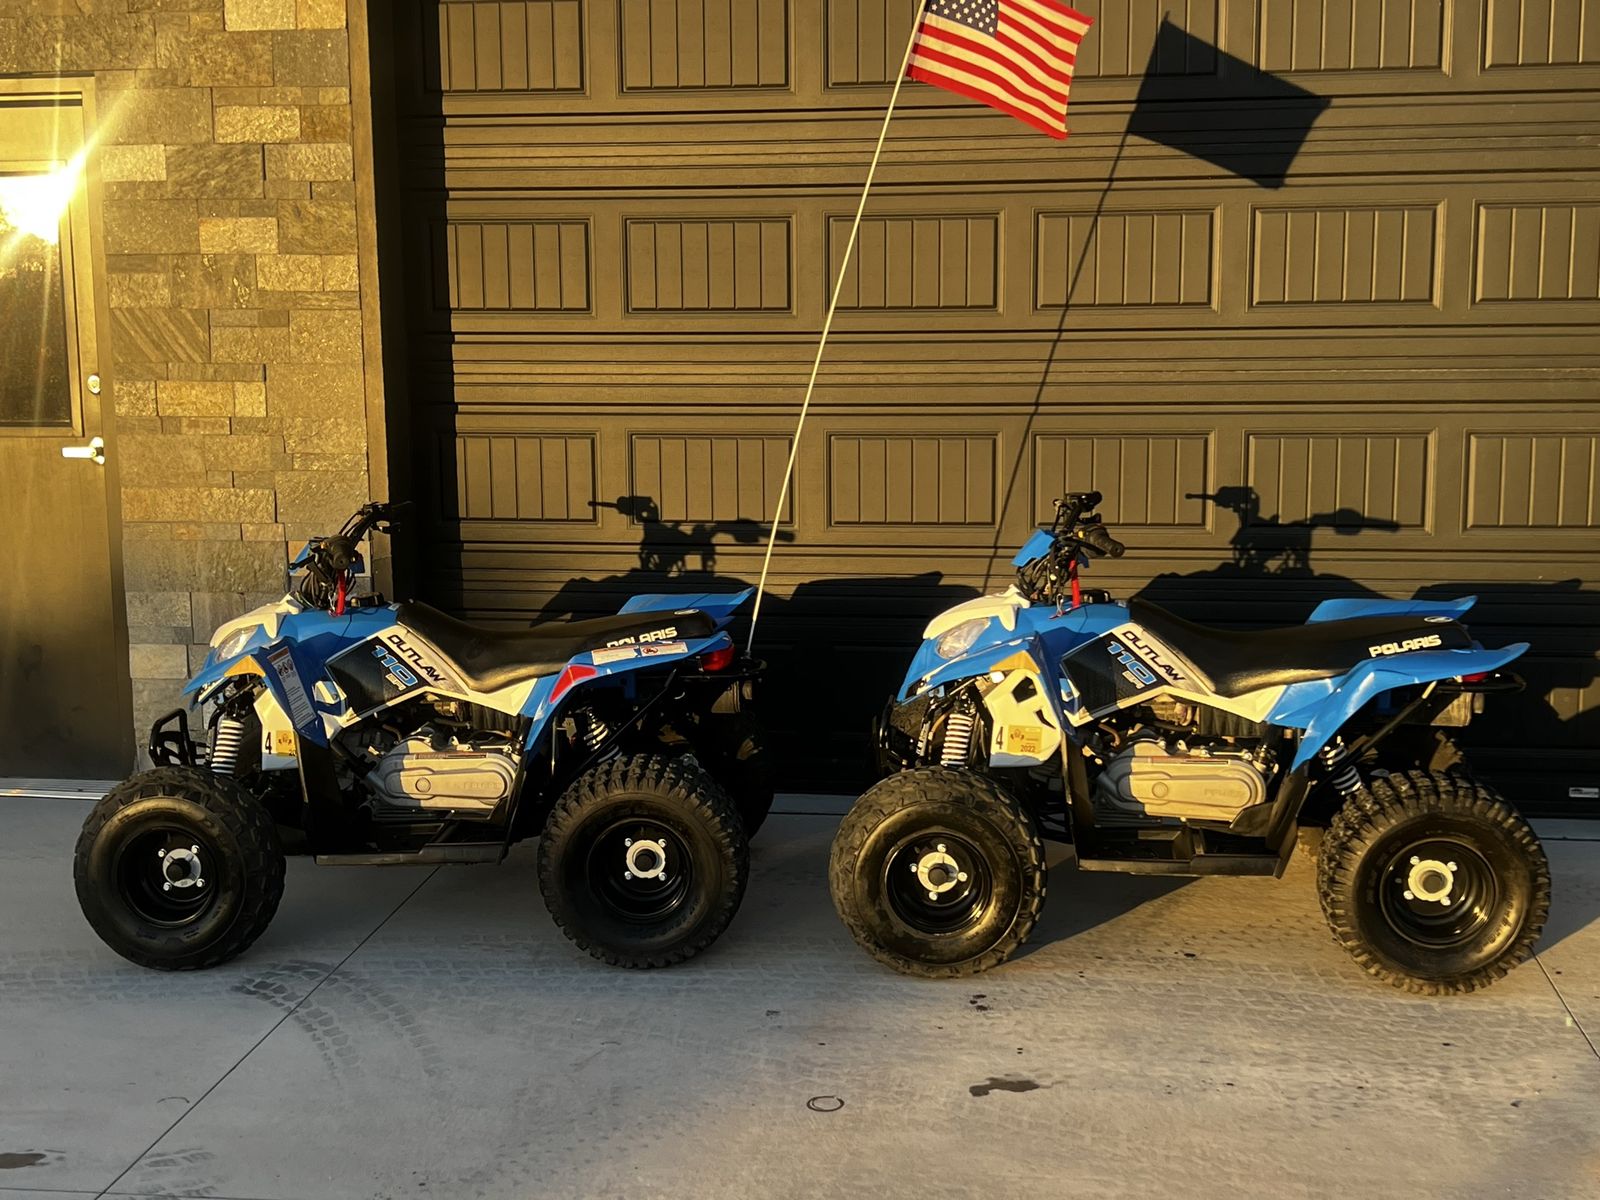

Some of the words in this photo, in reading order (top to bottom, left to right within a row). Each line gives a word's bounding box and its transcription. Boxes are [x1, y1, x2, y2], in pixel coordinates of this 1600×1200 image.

[371, 645, 419, 687] 110
[387, 634, 447, 682] OUTLAW
[1107, 641, 1157, 685] 110
[1122, 630, 1186, 681] OUTLAW
[1368, 634, 1442, 658] POLARIS
[264, 731, 272, 755] 4
[995, 726, 1004, 750] 4
